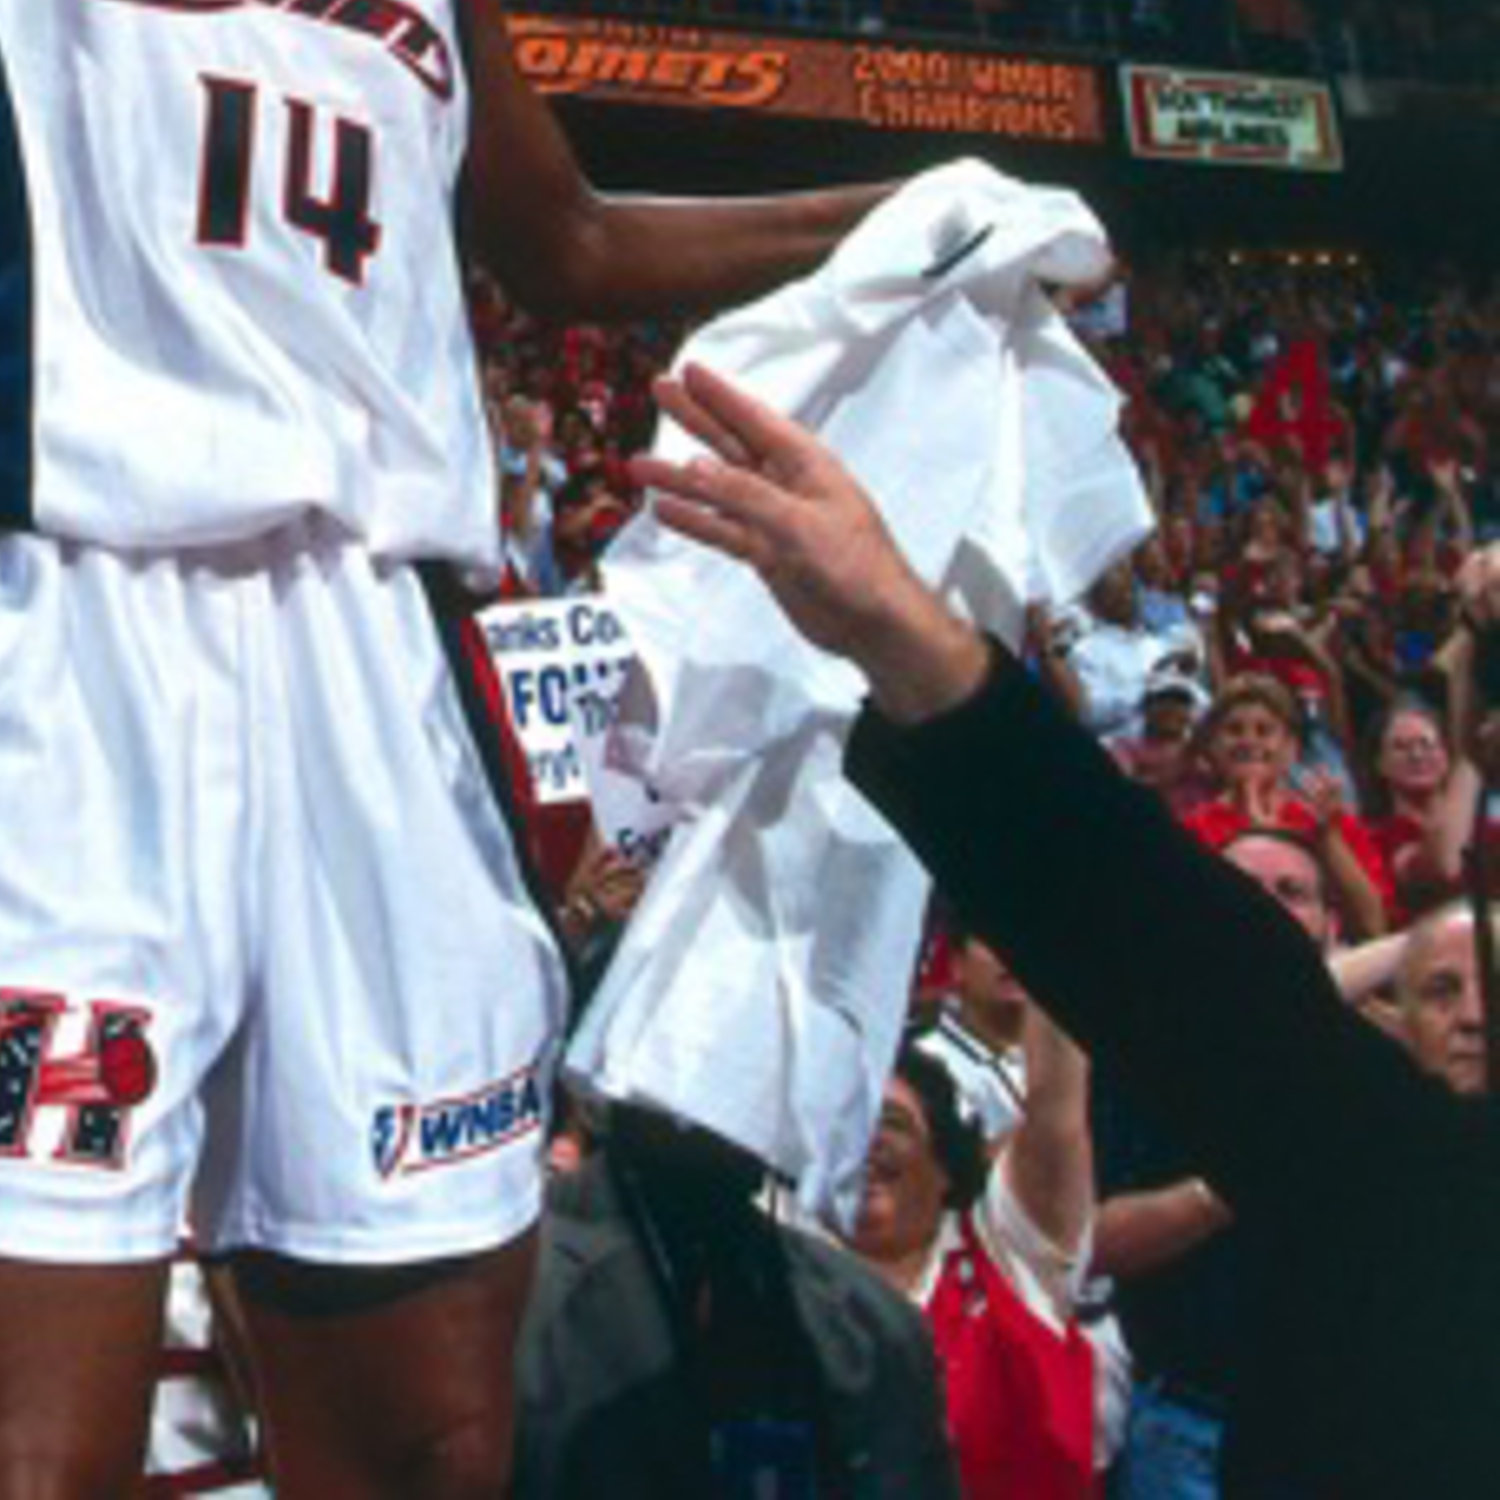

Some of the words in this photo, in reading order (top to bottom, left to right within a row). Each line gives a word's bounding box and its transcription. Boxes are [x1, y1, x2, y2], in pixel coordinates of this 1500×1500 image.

[861, 86, 1076, 140] CHAMPIONS
[194, 72, 382, 288] 14
[419, 1077, 542, 1154] WNBA
